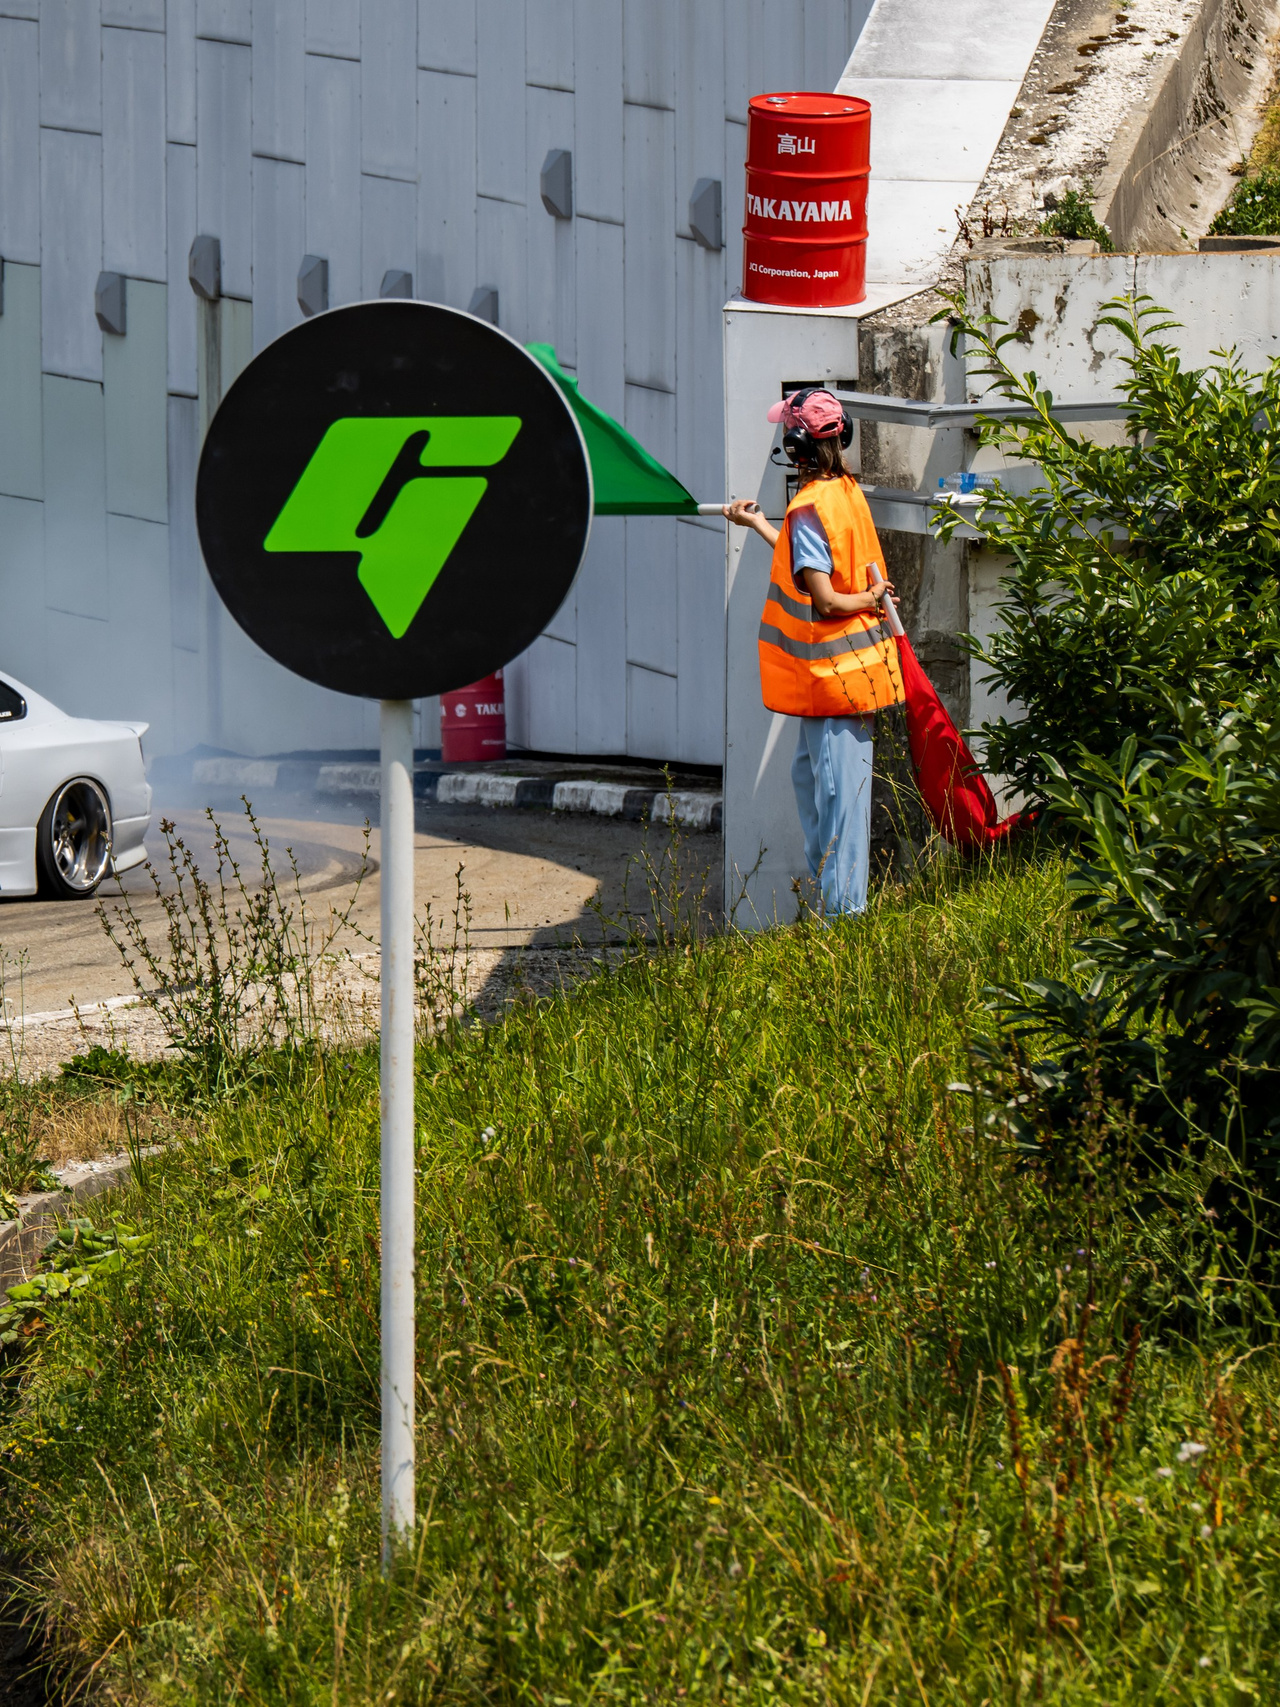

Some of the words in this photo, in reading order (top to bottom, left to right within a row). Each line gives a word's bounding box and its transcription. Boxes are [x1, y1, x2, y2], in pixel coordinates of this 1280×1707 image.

[777, 133, 816, 155] 高山
[747, 193, 852, 222] TAKAYAMA
[759, 264, 811, 279] Corporation,
[813, 269, 839, 279] Japan
